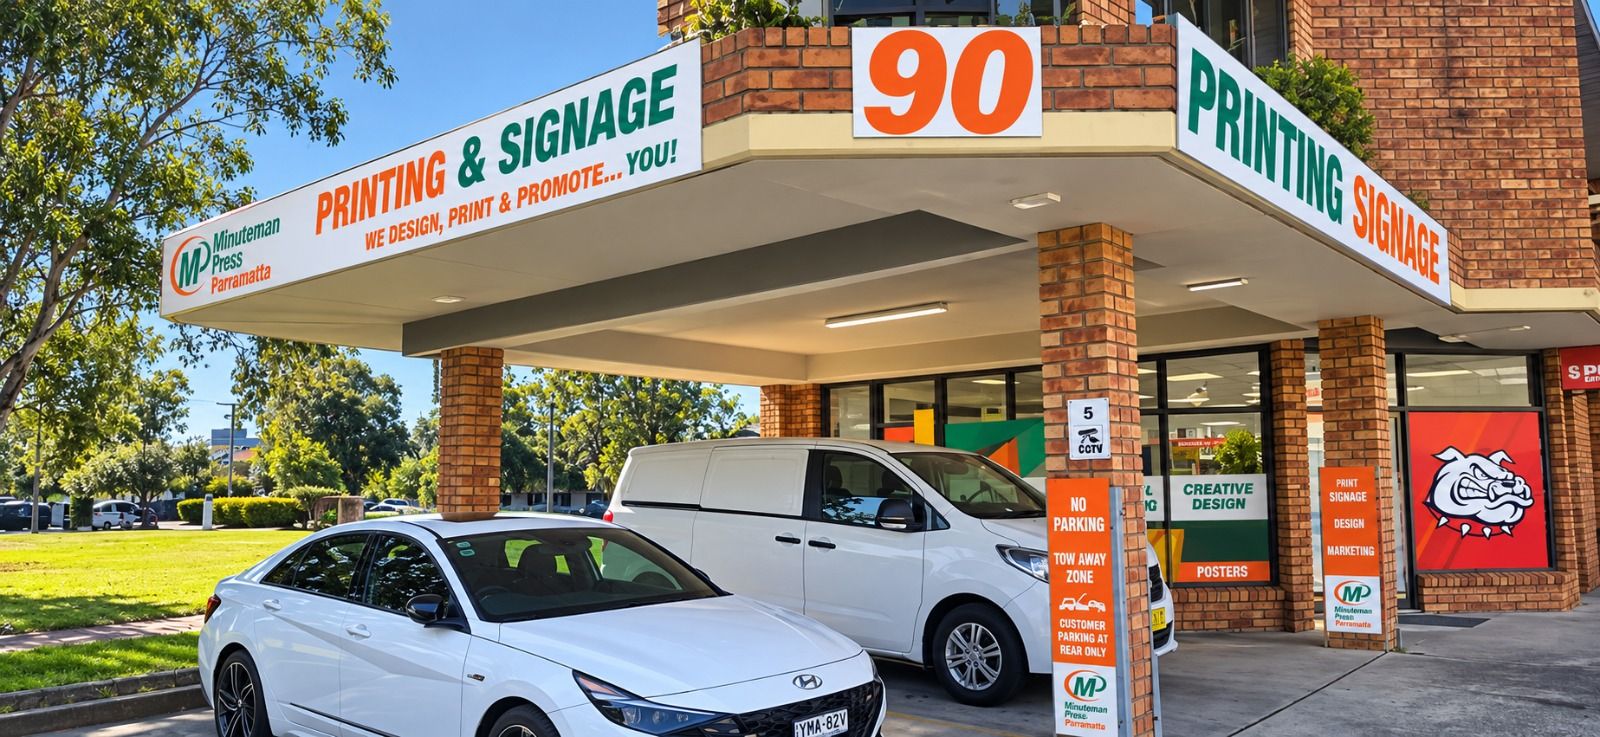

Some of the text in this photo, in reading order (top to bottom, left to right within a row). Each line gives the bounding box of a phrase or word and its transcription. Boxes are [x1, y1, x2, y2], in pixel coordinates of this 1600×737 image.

[863, 29, 1034, 136] 90
[315, 64, 677, 235] PRINTING & SIGNAGE
[1188, 47, 1440, 286] PRINTING SIGNAGE
[365, 138, 677, 251] WE DESIGN, PRINT & PROMOTE... YOU!
[213, 217, 281, 253] Minuteman
[178, 241, 212, 289] MP
[212, 251, 243, 275] Press
[211, 263, 272, 295] Parramatta
[1083, 406, 1094, 420] 5
[1078, 443, 1104, 454] CCTV
[1183, 483, 1254, 496] CREATIVE
[1335, 478, 1359, 488] PRINT
[1070, 496, 1087, 512] NO
[1192, 497, 1246, 511] DESIGN
[1329, 491, 1368, 503] SIGNAGE
[1053, 516, 1105, 532] PARKING
[1333, 518, 1365, 529] DESIGN
[1326, 545, 1375, 557] MARKETING
[1053, 552, 1107, 567] TOW AWAY
[1066, 569, 1094, 584] ZONE
[1196, 565, 1249, 579] POSTERS
[1059, 618, 1106, 631] CUSTOMER
[1057, 631, 1109, 644] PARKING AT
[1060, 644, 1107, 658] REAR ONLY
